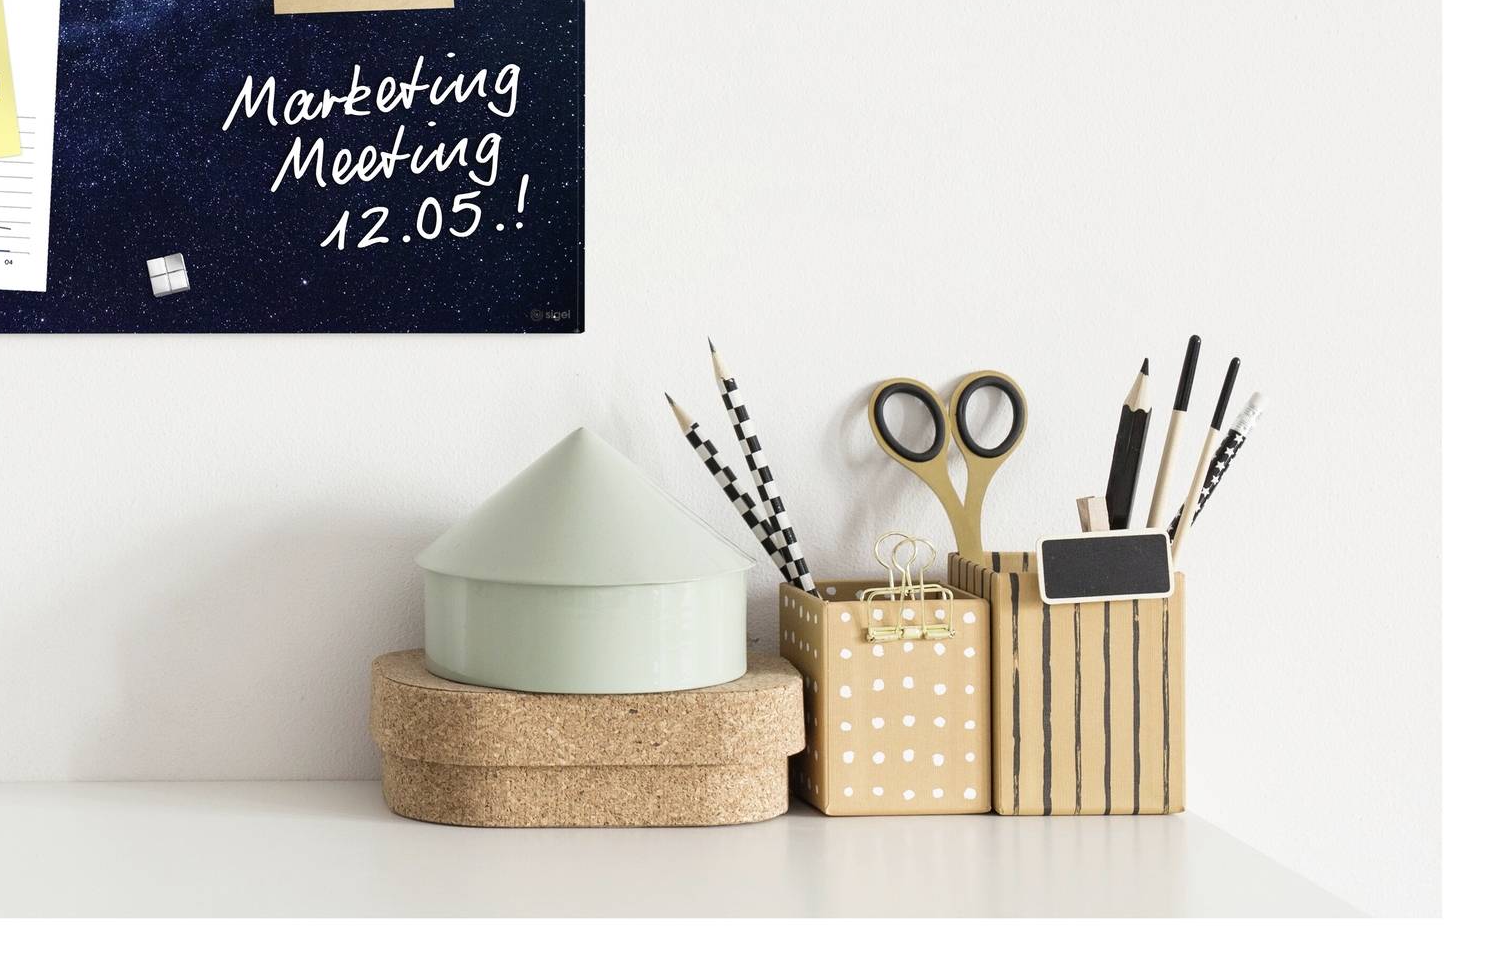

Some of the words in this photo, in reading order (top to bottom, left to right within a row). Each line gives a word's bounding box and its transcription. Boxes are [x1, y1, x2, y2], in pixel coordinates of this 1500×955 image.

[222, 52, 521, 132] Marketing
[270, 120, 502, 193] Meeting
[319, 174, 530, 251] 12.05.!
[546, 310, 570, 321] sigel
